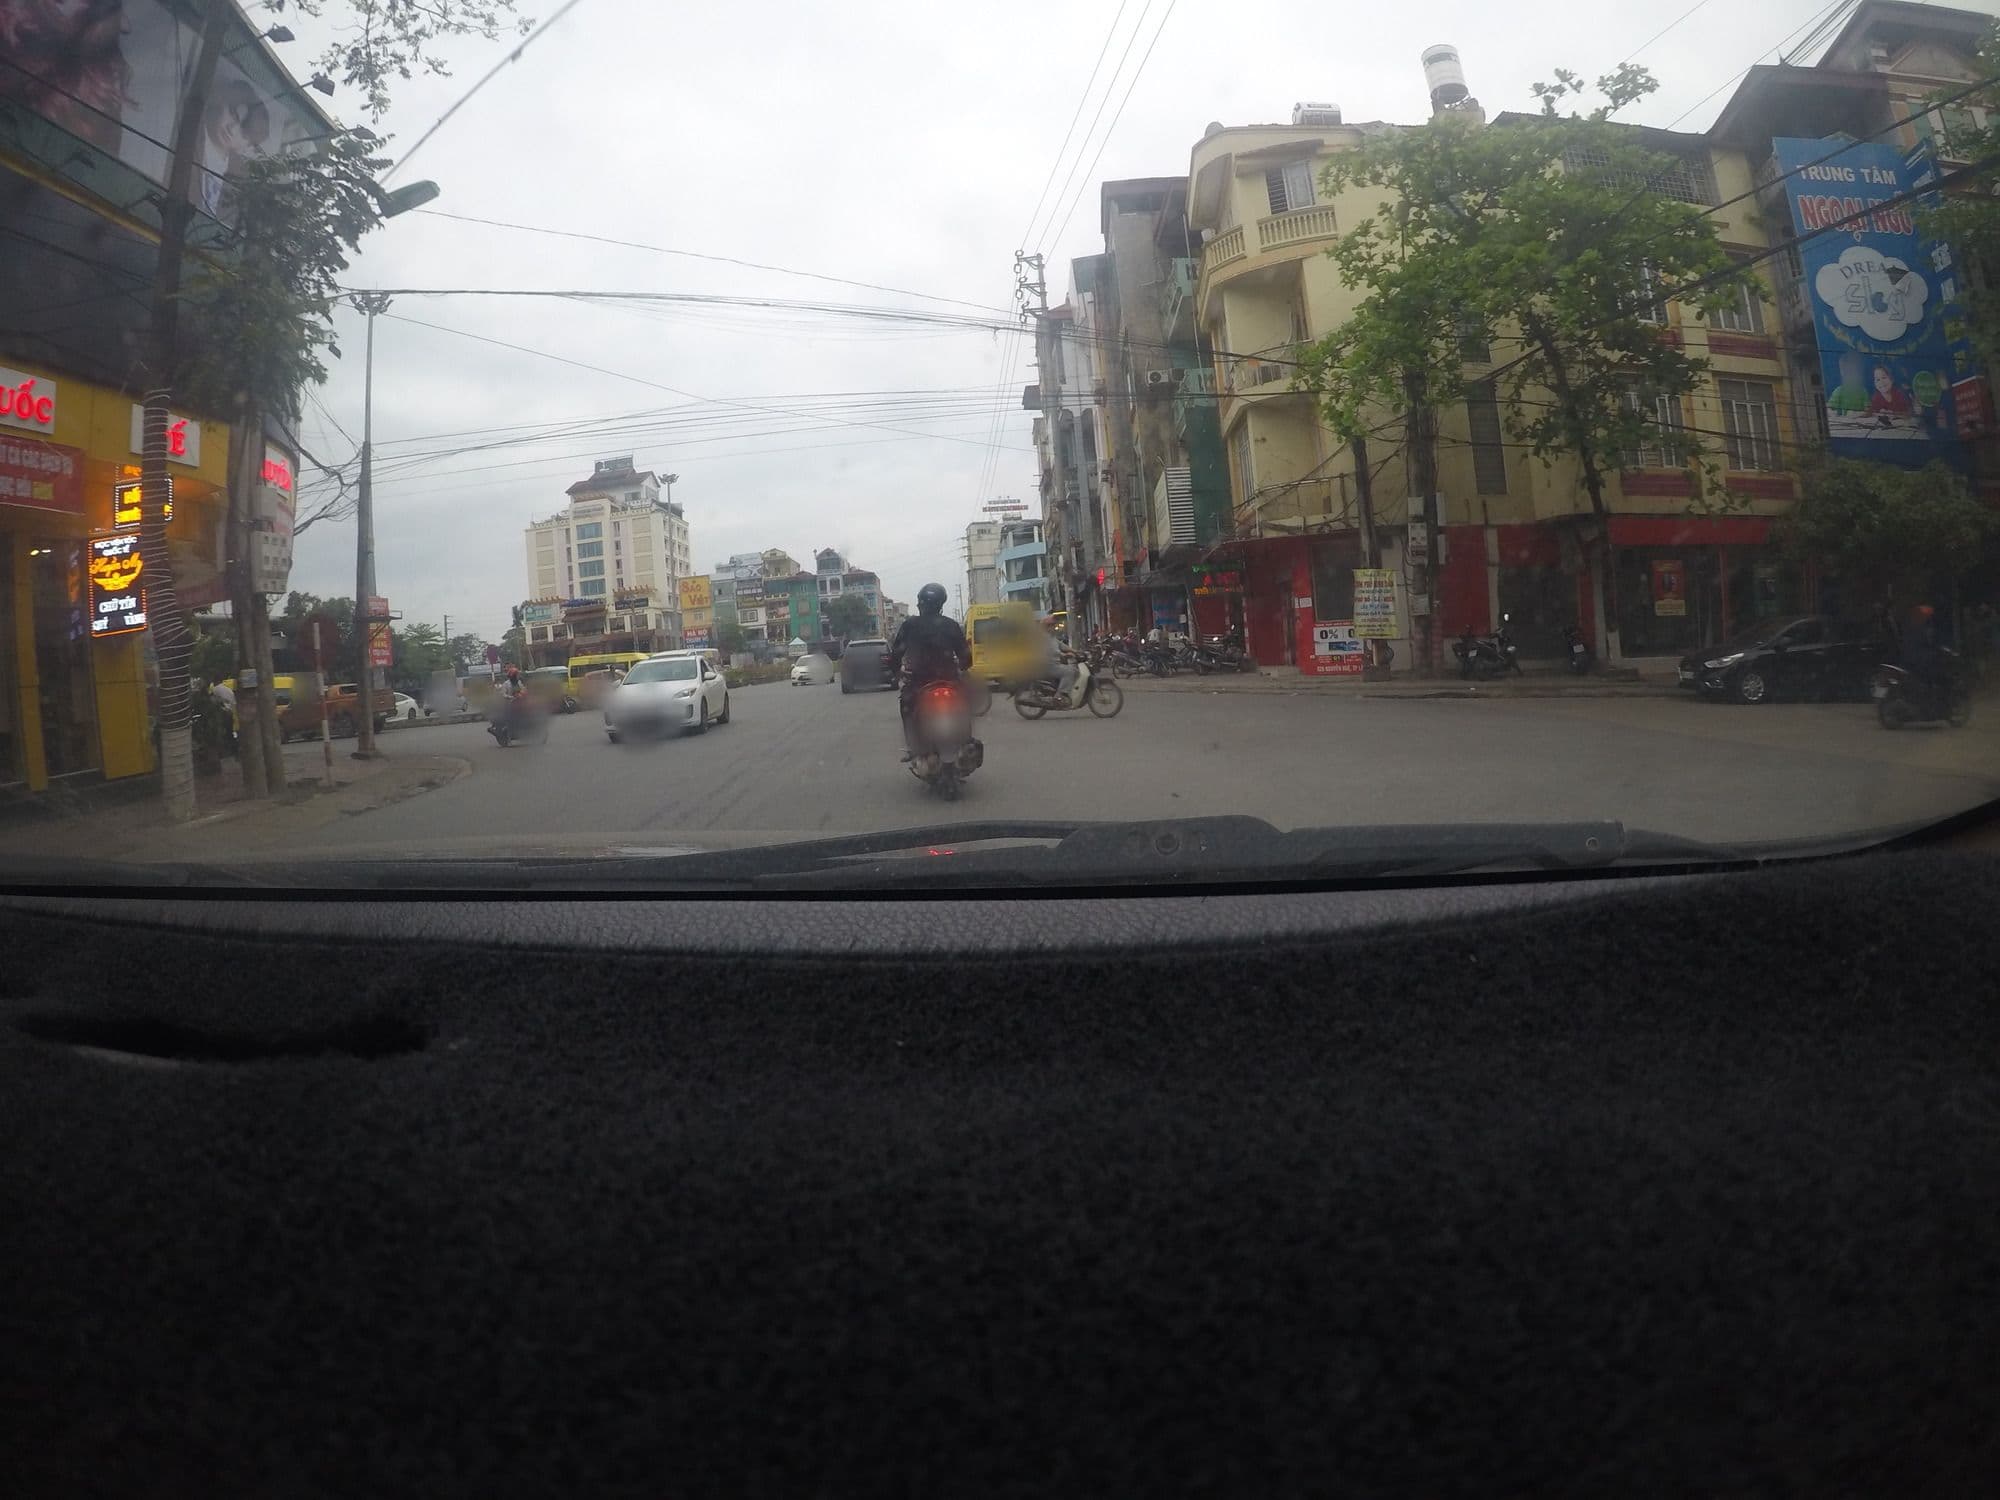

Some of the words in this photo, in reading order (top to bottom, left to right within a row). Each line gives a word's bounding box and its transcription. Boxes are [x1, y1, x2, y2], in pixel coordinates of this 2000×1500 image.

[1796, 164, 1855, 183] TRUNG
[1860, 165, 1897, 185] TÂM
[1839, 260, 1889, 280] DREA
[1319, 629, 1339, 640] 0%
